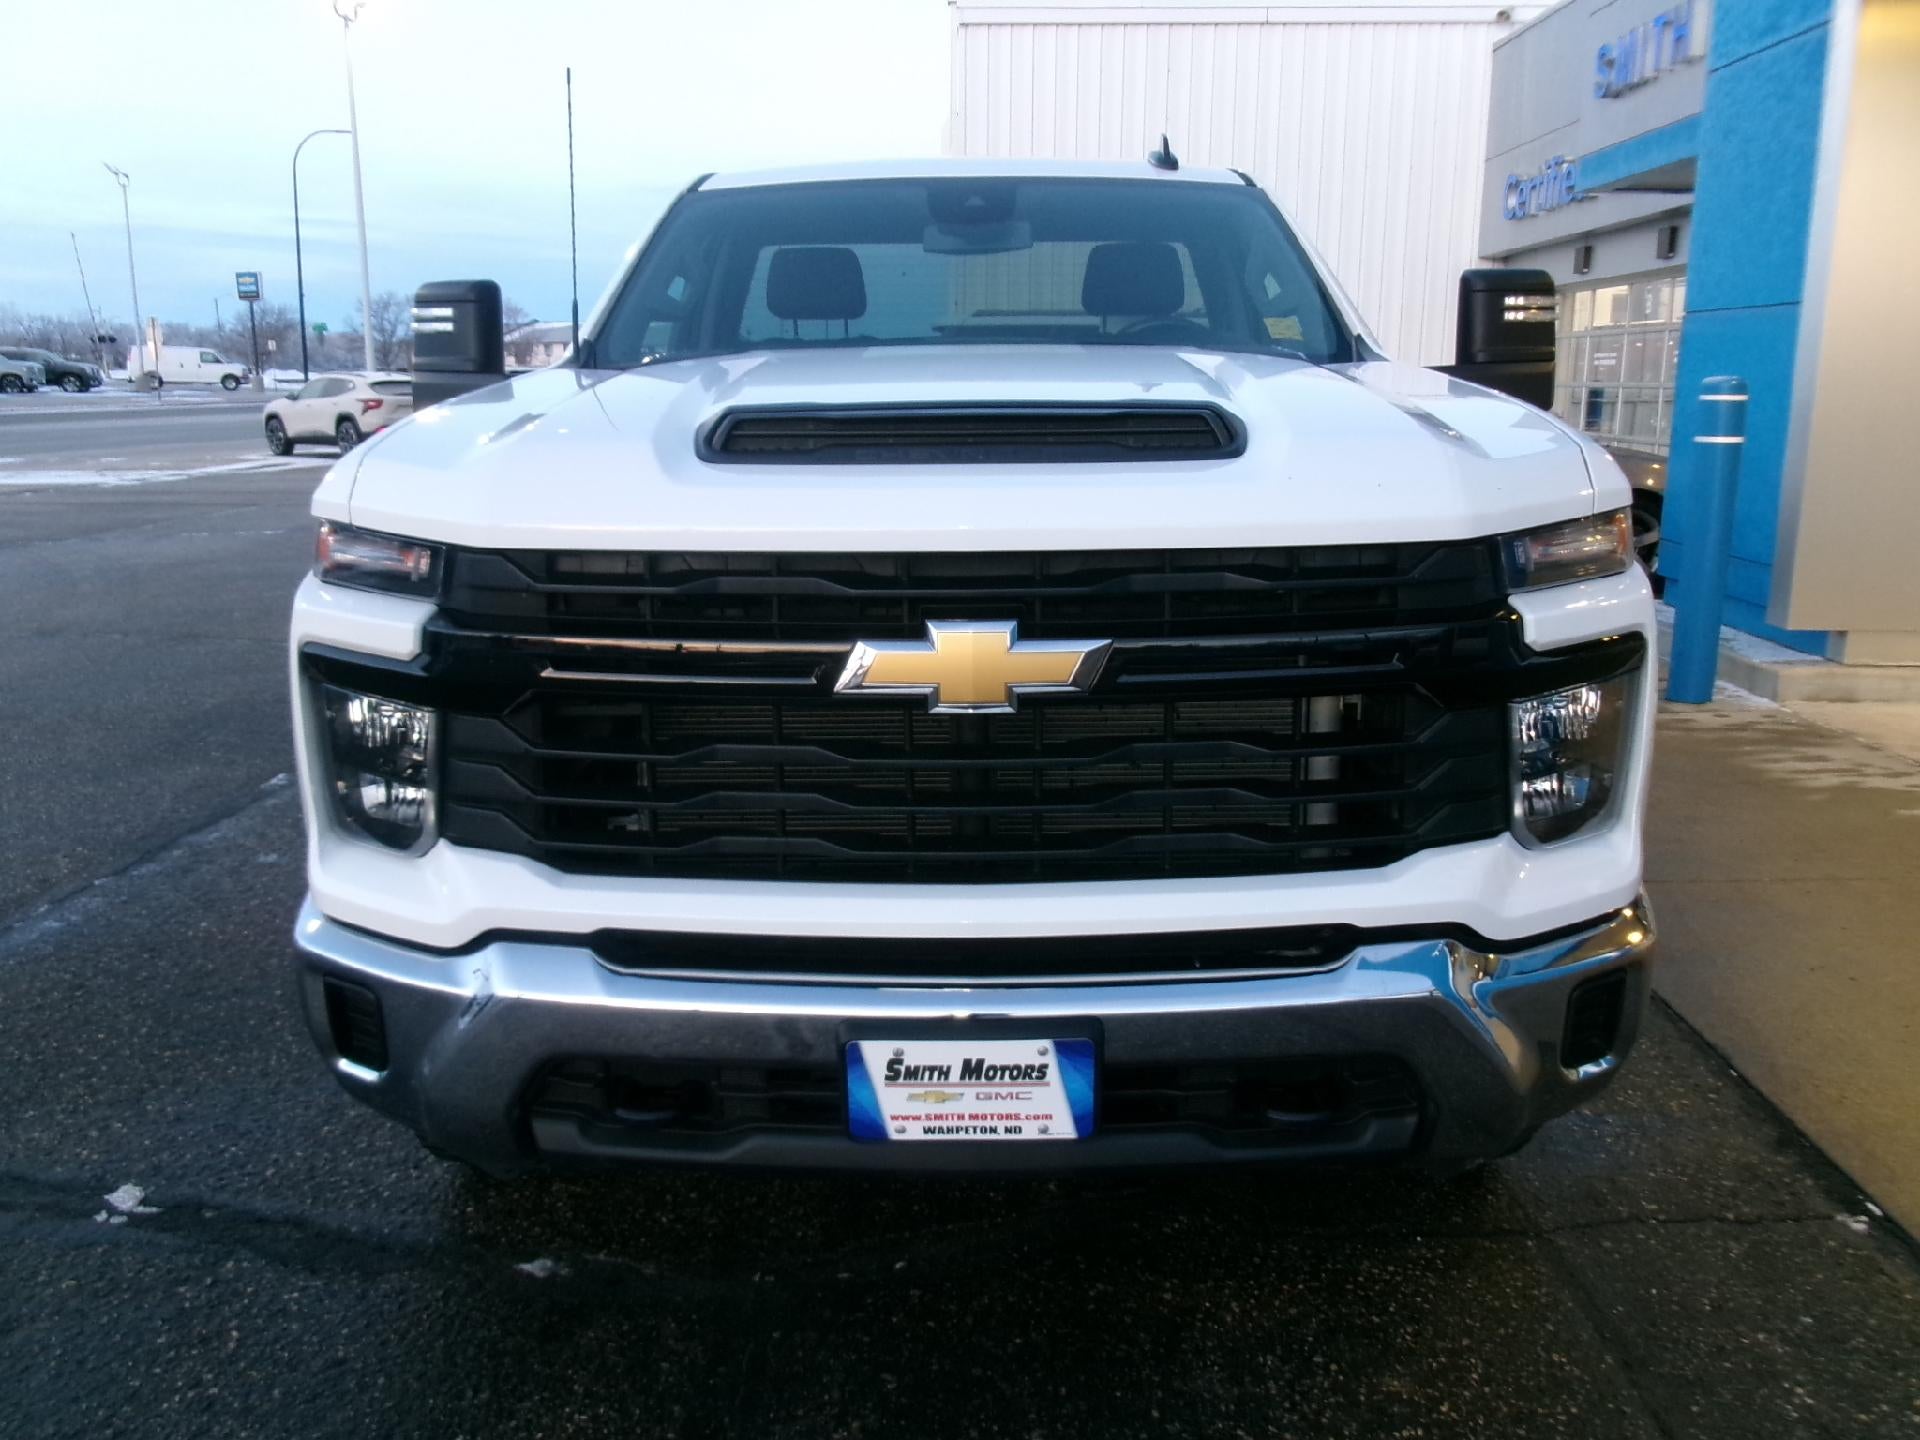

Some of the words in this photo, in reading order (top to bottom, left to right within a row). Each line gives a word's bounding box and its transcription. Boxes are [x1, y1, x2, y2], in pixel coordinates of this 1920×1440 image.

[1594, 0, 1703, 98] SMITH
[1503, 155, 1584, 220] Certifie
[975, 1091, 1033, 1101] GMC
[1003, 1125, 1023, 1135] ND
